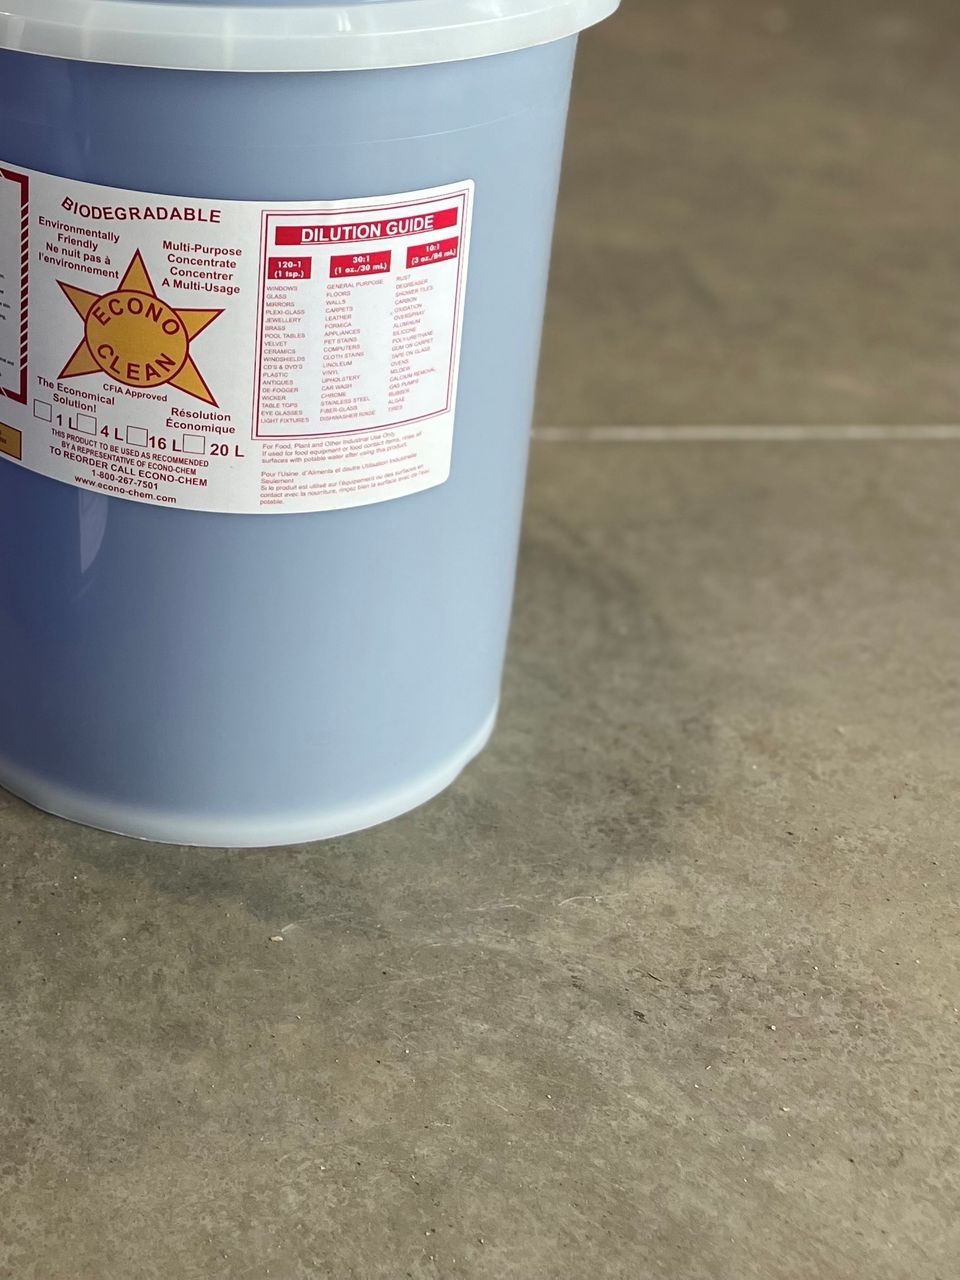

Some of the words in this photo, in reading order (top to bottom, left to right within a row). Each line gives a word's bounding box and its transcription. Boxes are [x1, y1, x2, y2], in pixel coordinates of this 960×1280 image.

[61, 196, 222, 223] BIODEGRADABLE
[39, 216, 120, 244] Environmentally
[301, 222, 381, 242] DILUTION
[385, 214, 435, 236] GUIDE
[46, 242, 59, 254] Ne
[61, 246, 81, 260] nuit
[84, 252, 101, 265] pas
[105, 255, 111, 265] à
[58, 233, 98, 252] Friendly
[163, 240, 242, 257] Multi-Purpose
[39, 252, 119, 280] l'environnement
[168, 253, 237, 269] Concentrate
[277, 260, 302, 269] 120-1
[352, 255, 370, 264] 30:1
[170, 266, 234, 281] Concentrer
[161, 278, 171, 288] A
[173, 279, 240, 295] Multi-Usage
[92, 297, 180, 336] ECONO
[97, 343, 176, 381] CLEAN
[37, 376, 54, 390] The
[57, 384, 115, 405] Economical
[103, 383, 124, 394] CFIA
[125, 387, 168, 402] Approved
[53, 393, 97, 413] Solution!
[171, 407, 231, 422] Résolution
[56, 414, 63, 426] 1
[68, 417, 78, 430] L
[100, 425, 110, 438] 4
[115, 428, 124, 441] L
[149, 437, 167, 450] 16
[172, 439, 182, 452] L
[210, 443, 229, 457] 20
[235, 445, 245, 458] L
[166, 418, 236, 435] Économique
[51, 428, 66, 440] THIS
[66, 432, 98, 448] PRODUCT
[99, 440, 109, 450] TO
[110, 443, 120, 453] BE
[121, 446, 139, 457] USED
[141, 451, 151, 459] AS
[152, 453, 209, 467] RECOMMENDED
[61, 441, 71, 450] BY
[71, 443, 77, 451] A
[76, 445, 135, 466] REPRESENTATIVE
[136, 459, 147, 468] OF
[147, 461, 197, 476] ECONO-CHEM
[49, 446, 62, 457] TO
[63, 451, 108, 471] REORDER
[111, 463, 136, 476] CALL
[139, 470, 208, 487] ECONO-CHEM
[74, 475, 177, 504] www.econo-chem.com
[92, 469, 158, 490] 1-800-267-7501
